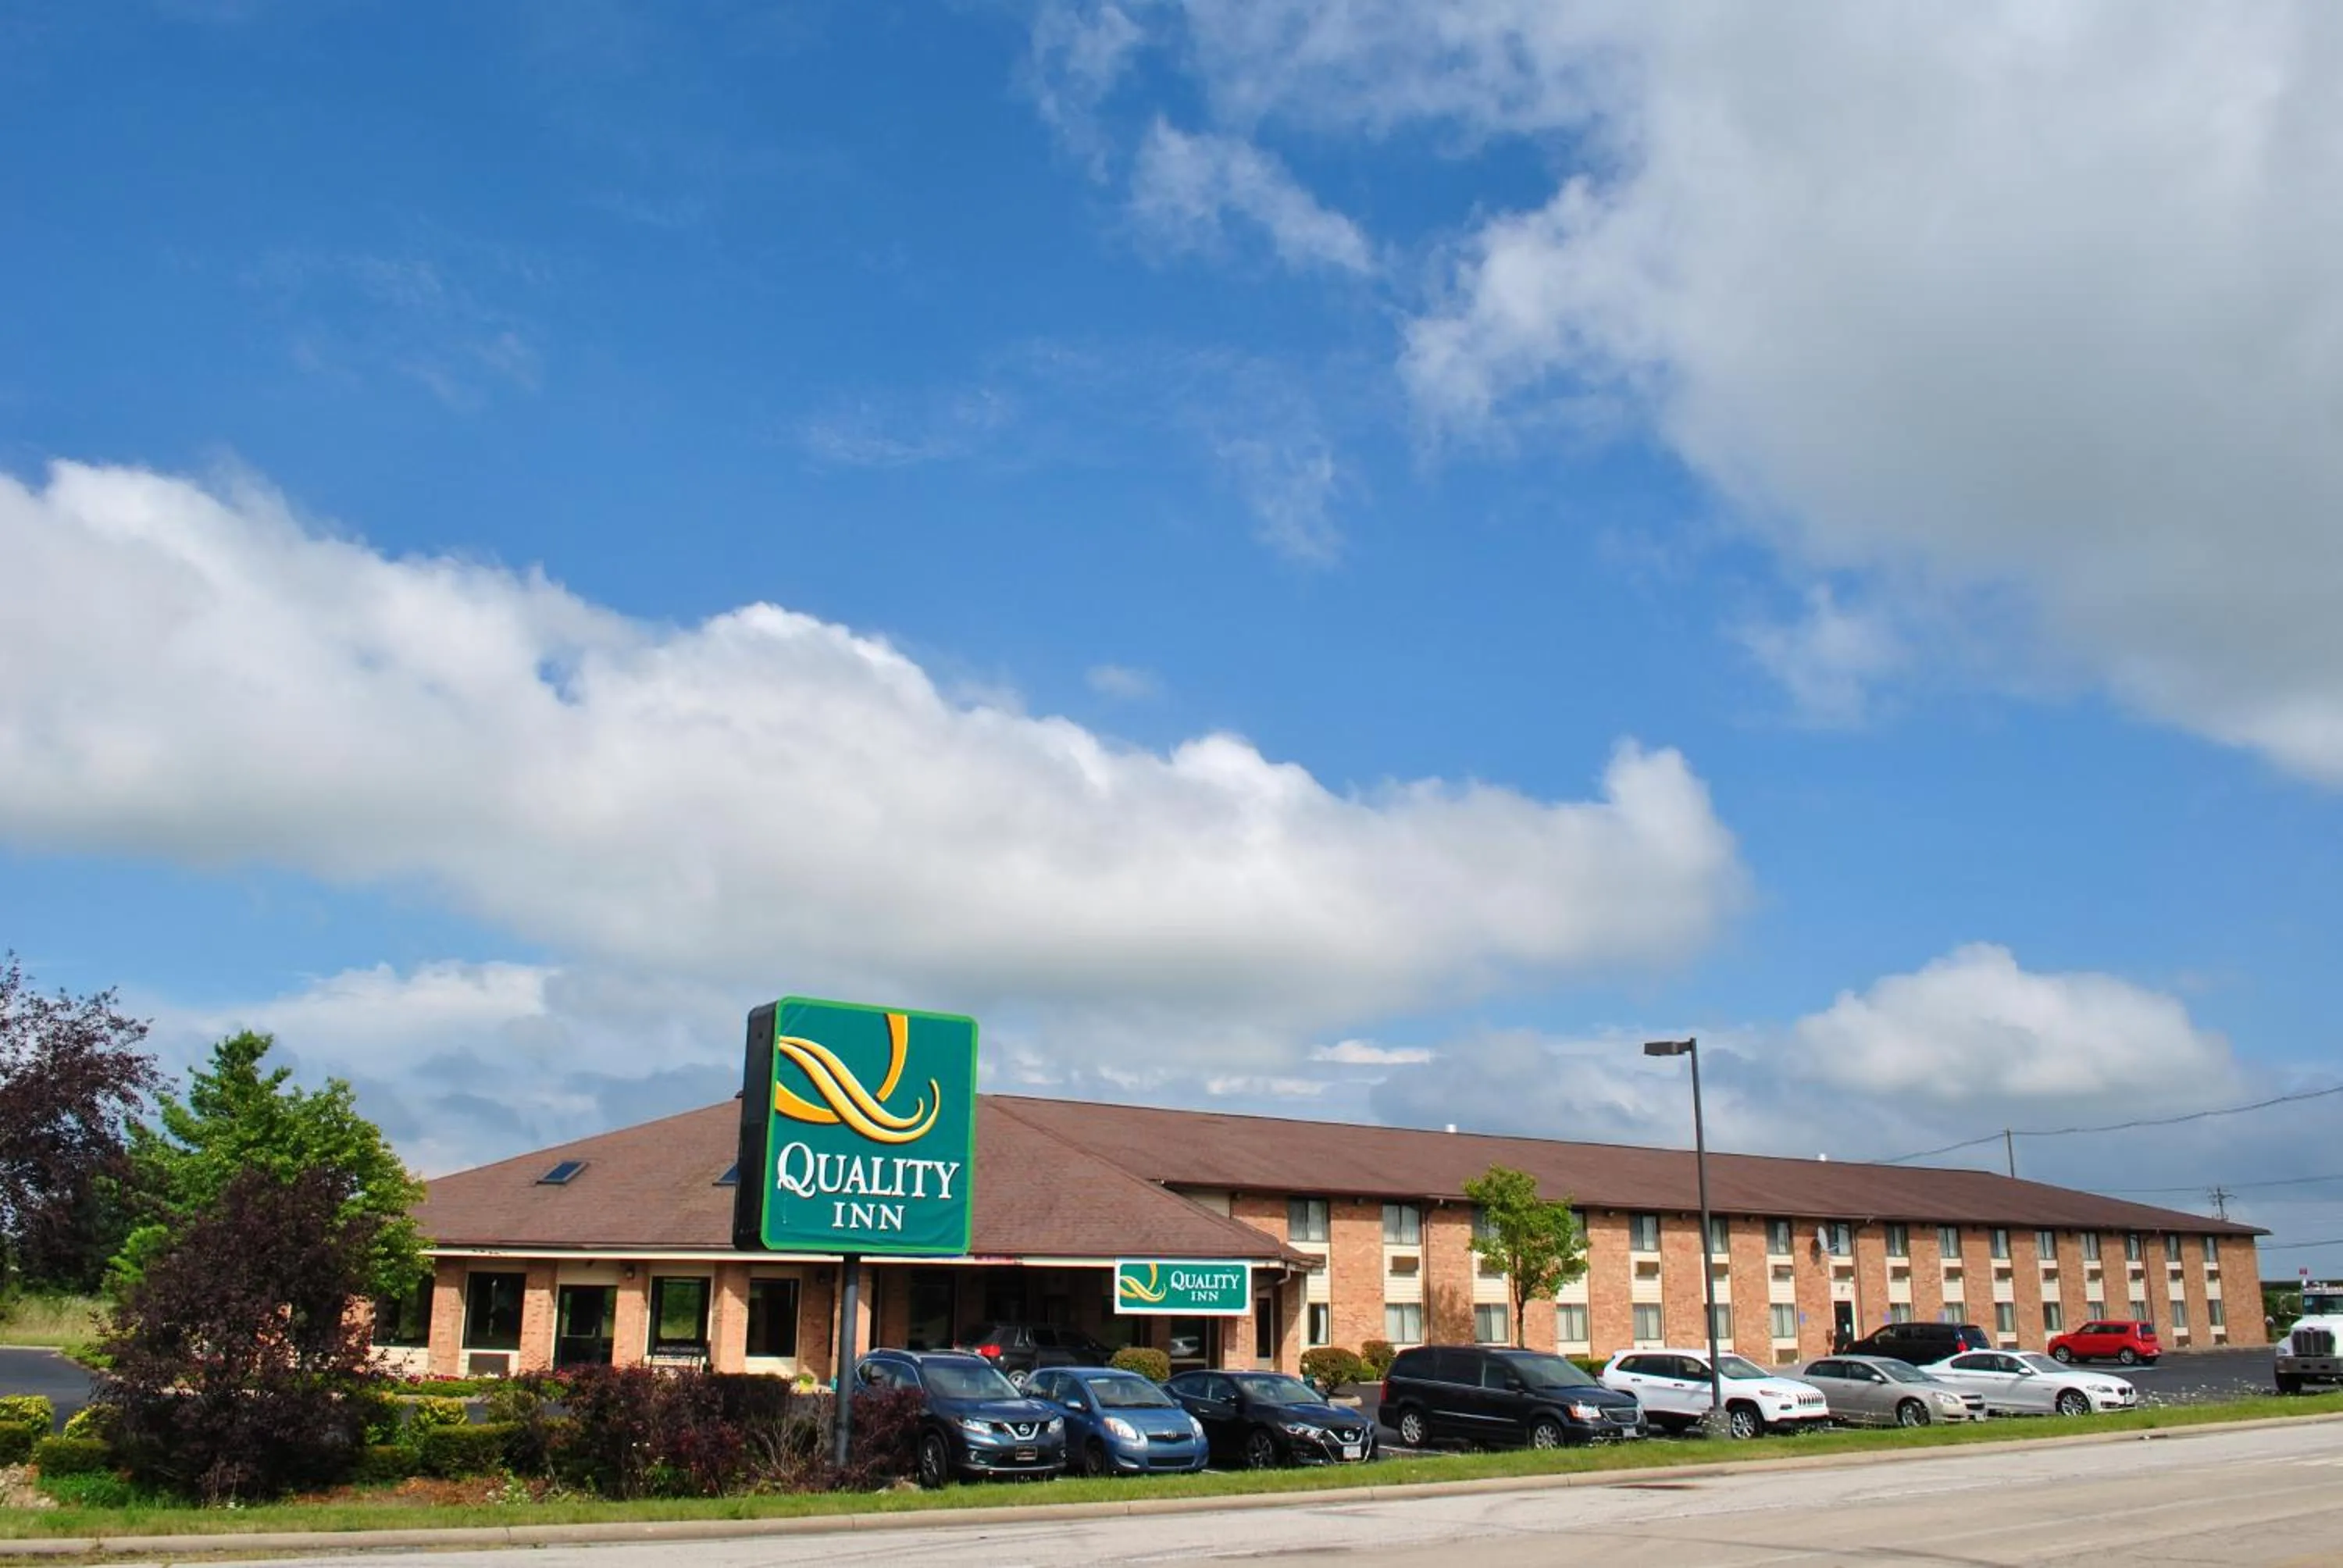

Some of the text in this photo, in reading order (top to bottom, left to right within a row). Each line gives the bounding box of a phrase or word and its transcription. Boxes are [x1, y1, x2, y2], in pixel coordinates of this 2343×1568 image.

[777, 1142, 960, 1199] QUALITY
[833, 1202, 904, 1230] INN
[1171, 1270, 1240, 1291] QUALITY
[1191, 1291, 1219, 1302] INN
